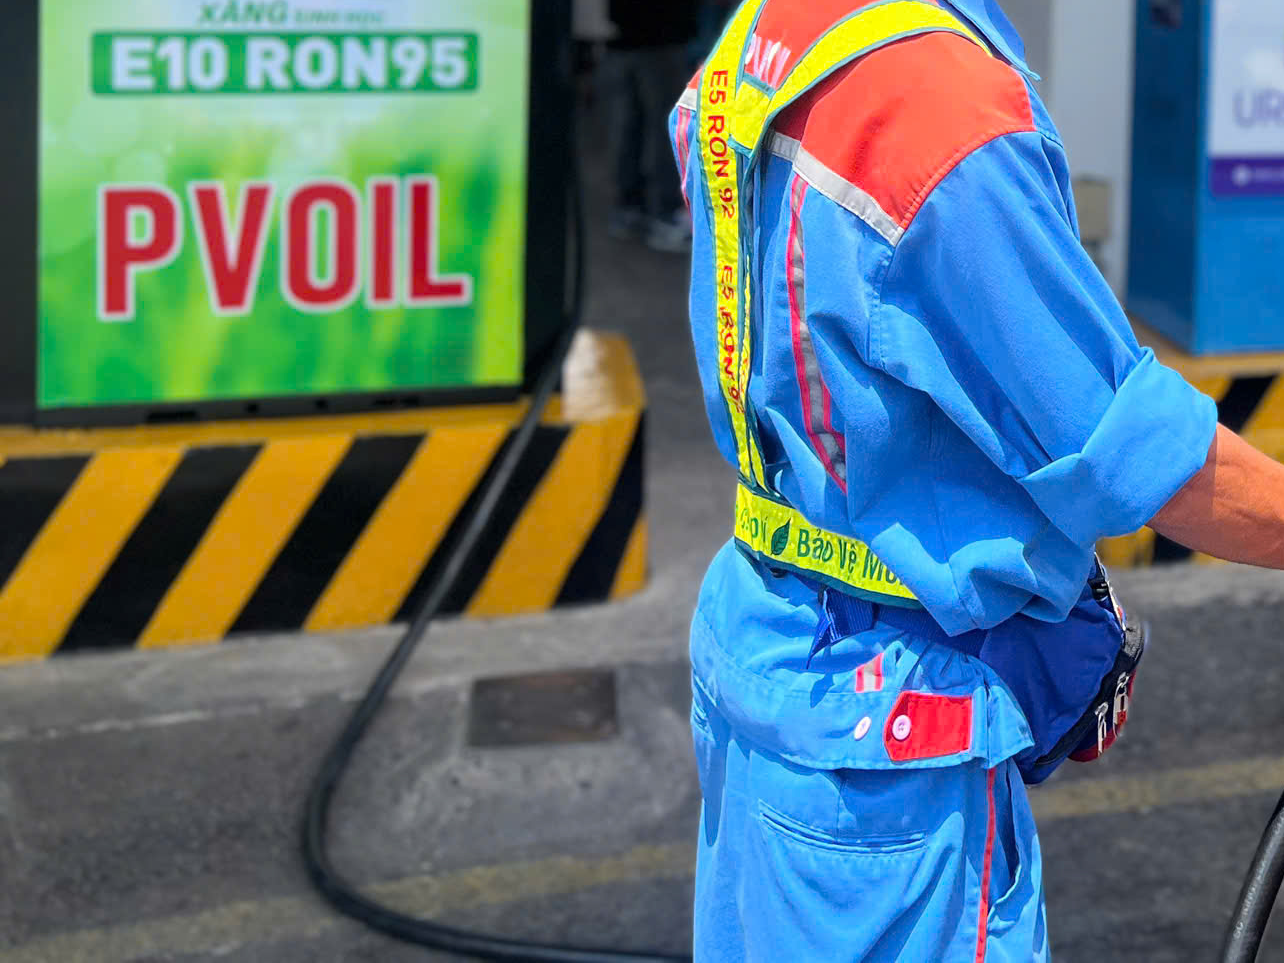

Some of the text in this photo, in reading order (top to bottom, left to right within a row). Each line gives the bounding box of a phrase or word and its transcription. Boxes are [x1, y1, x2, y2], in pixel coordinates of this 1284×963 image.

[111, 37, 468, 91] E10 RON95
[707, 69, 736, 220] E5 RON 92
[98, 175, 472, 322] PVOIL
[720, 265, 735, 301] E5
[720, 308, 736, 381] RON
[797, 527, 834, 563] Bảo
[837, 538, 857, 580] Vệ
